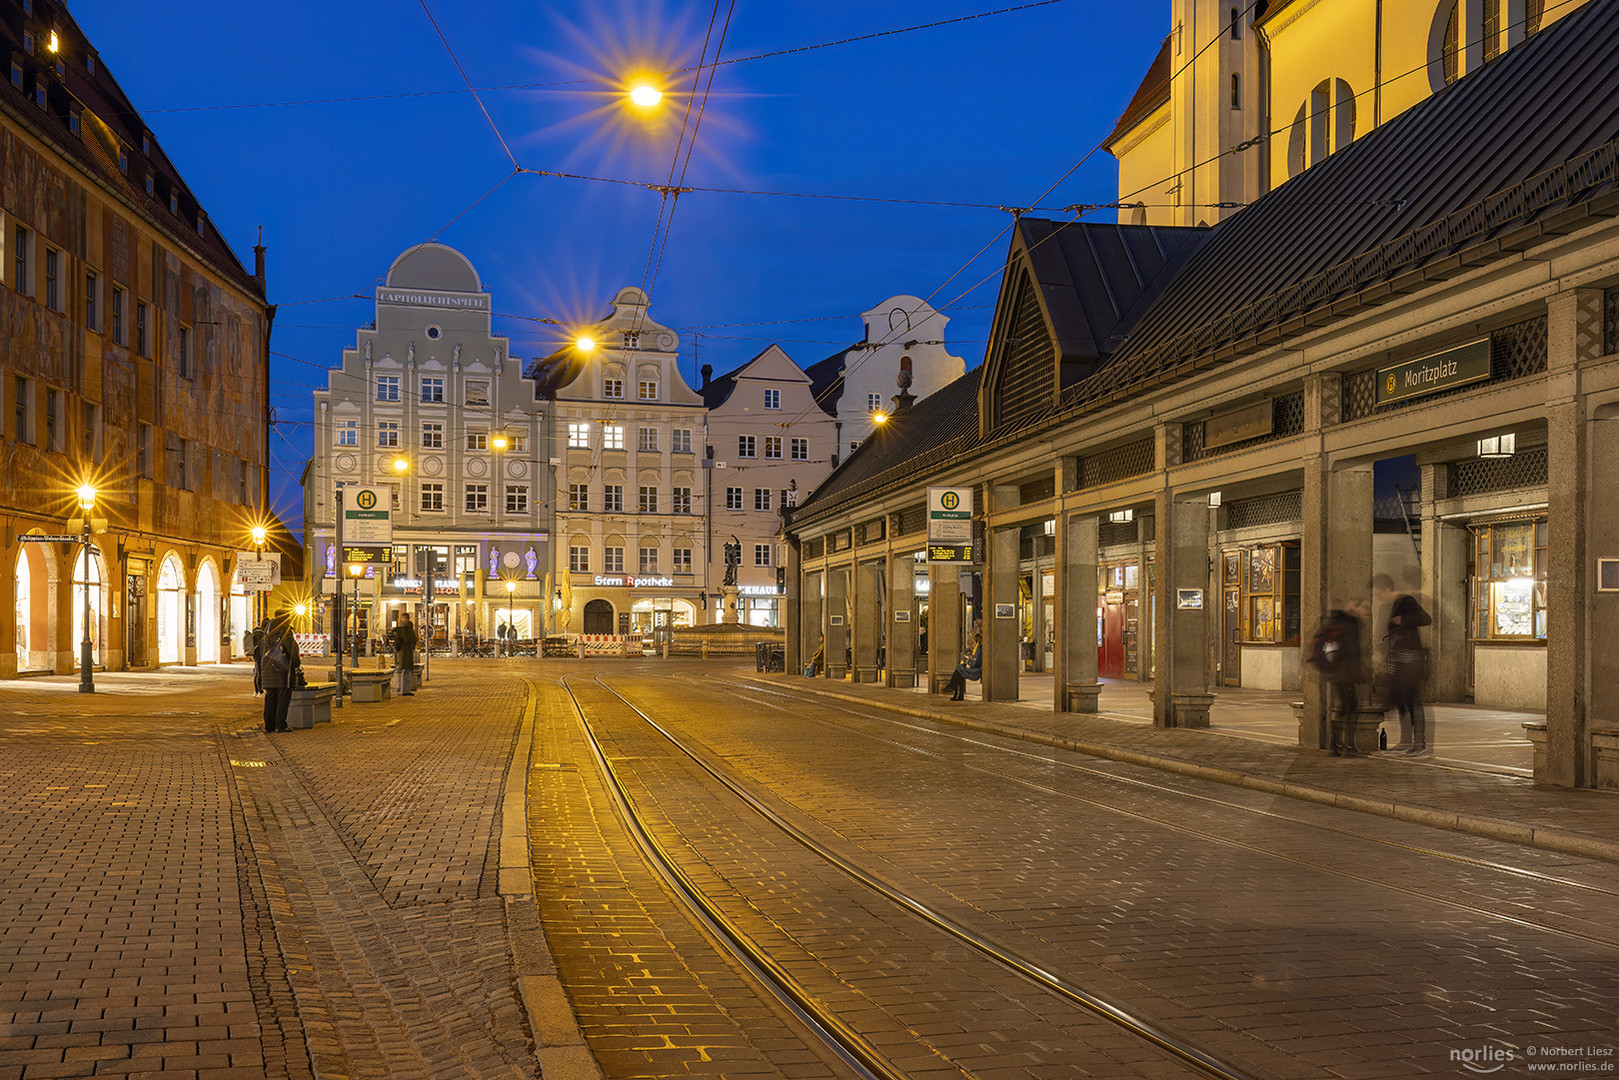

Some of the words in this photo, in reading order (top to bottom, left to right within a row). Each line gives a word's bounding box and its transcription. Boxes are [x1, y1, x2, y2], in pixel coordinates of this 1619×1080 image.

[1404, 360, 1457, 387] Moritzplatz
[594, 576, 623, 586] Stern
[626, 575, 673, 588] Apotheke
